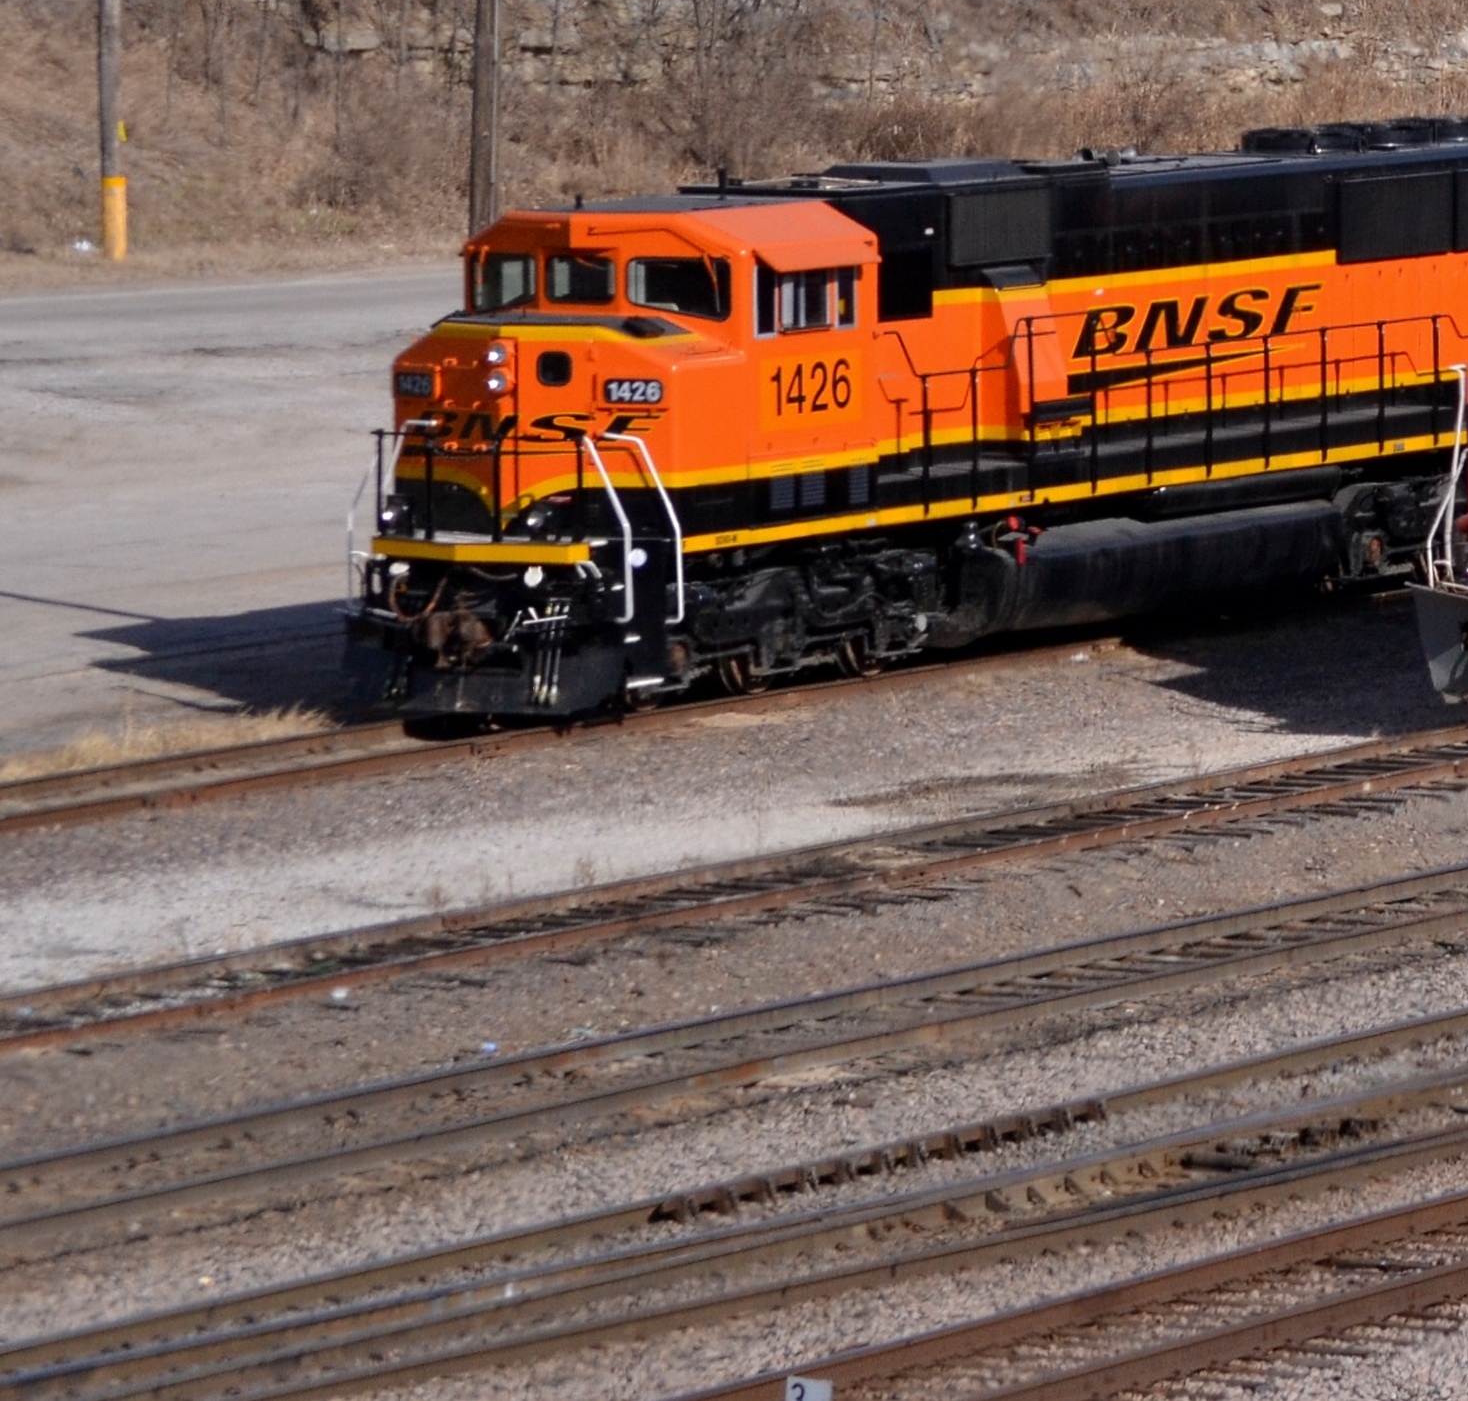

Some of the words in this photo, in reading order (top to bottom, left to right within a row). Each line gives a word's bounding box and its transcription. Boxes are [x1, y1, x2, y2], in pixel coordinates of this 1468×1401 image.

[1071, 283, 1322, 359] BNSF
[400, 374, 431, 394] 1426
[606, 381, 662, 402] 1426
[770, 358, 851, 416] 1426
[413, 411, 663, 442] BNSF
